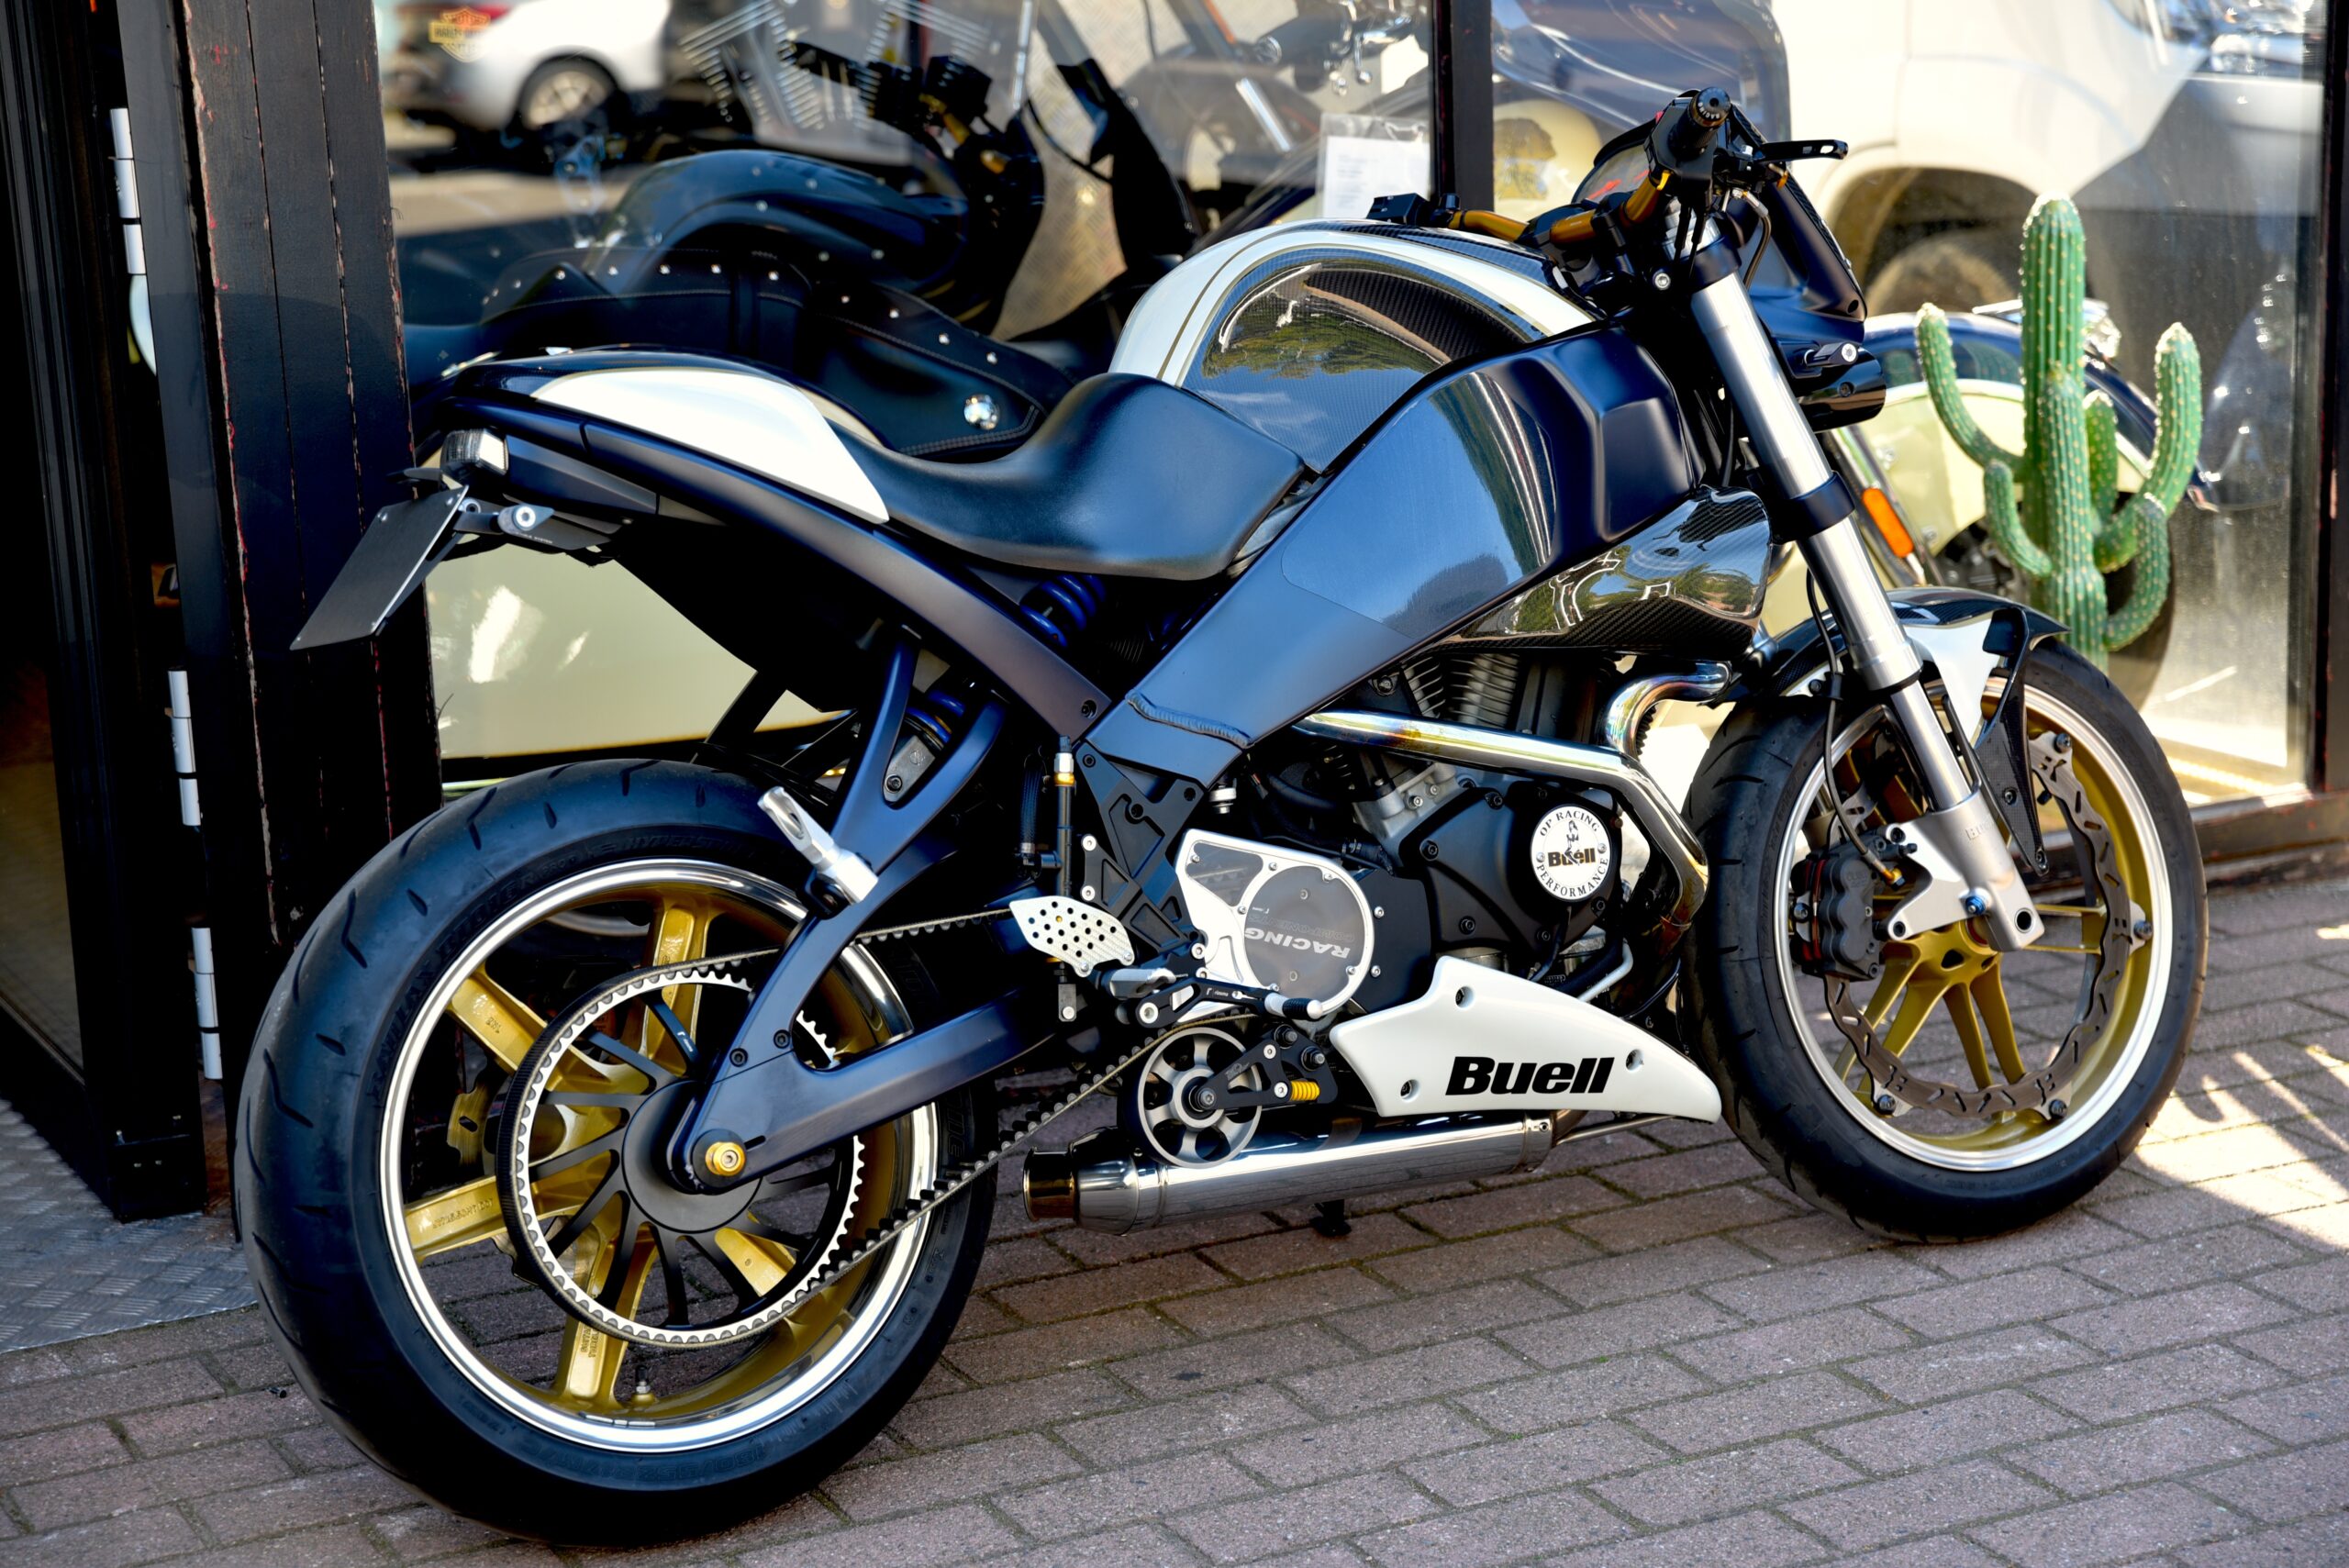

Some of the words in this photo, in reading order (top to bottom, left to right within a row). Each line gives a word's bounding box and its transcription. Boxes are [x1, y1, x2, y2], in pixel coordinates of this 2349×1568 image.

[1698, 102, 1720, 119] RACING
[1540, 819, 1553, 837] OP
[1555, 810, 1600, 832] RACING
[1547, 848, 1596, 868] Buell
[1536, 858, 1609, 897] PERFORMANCE
[1244, 927, 1352, 960] RACING
[1445, 1056, 1615, 1095] Buell
